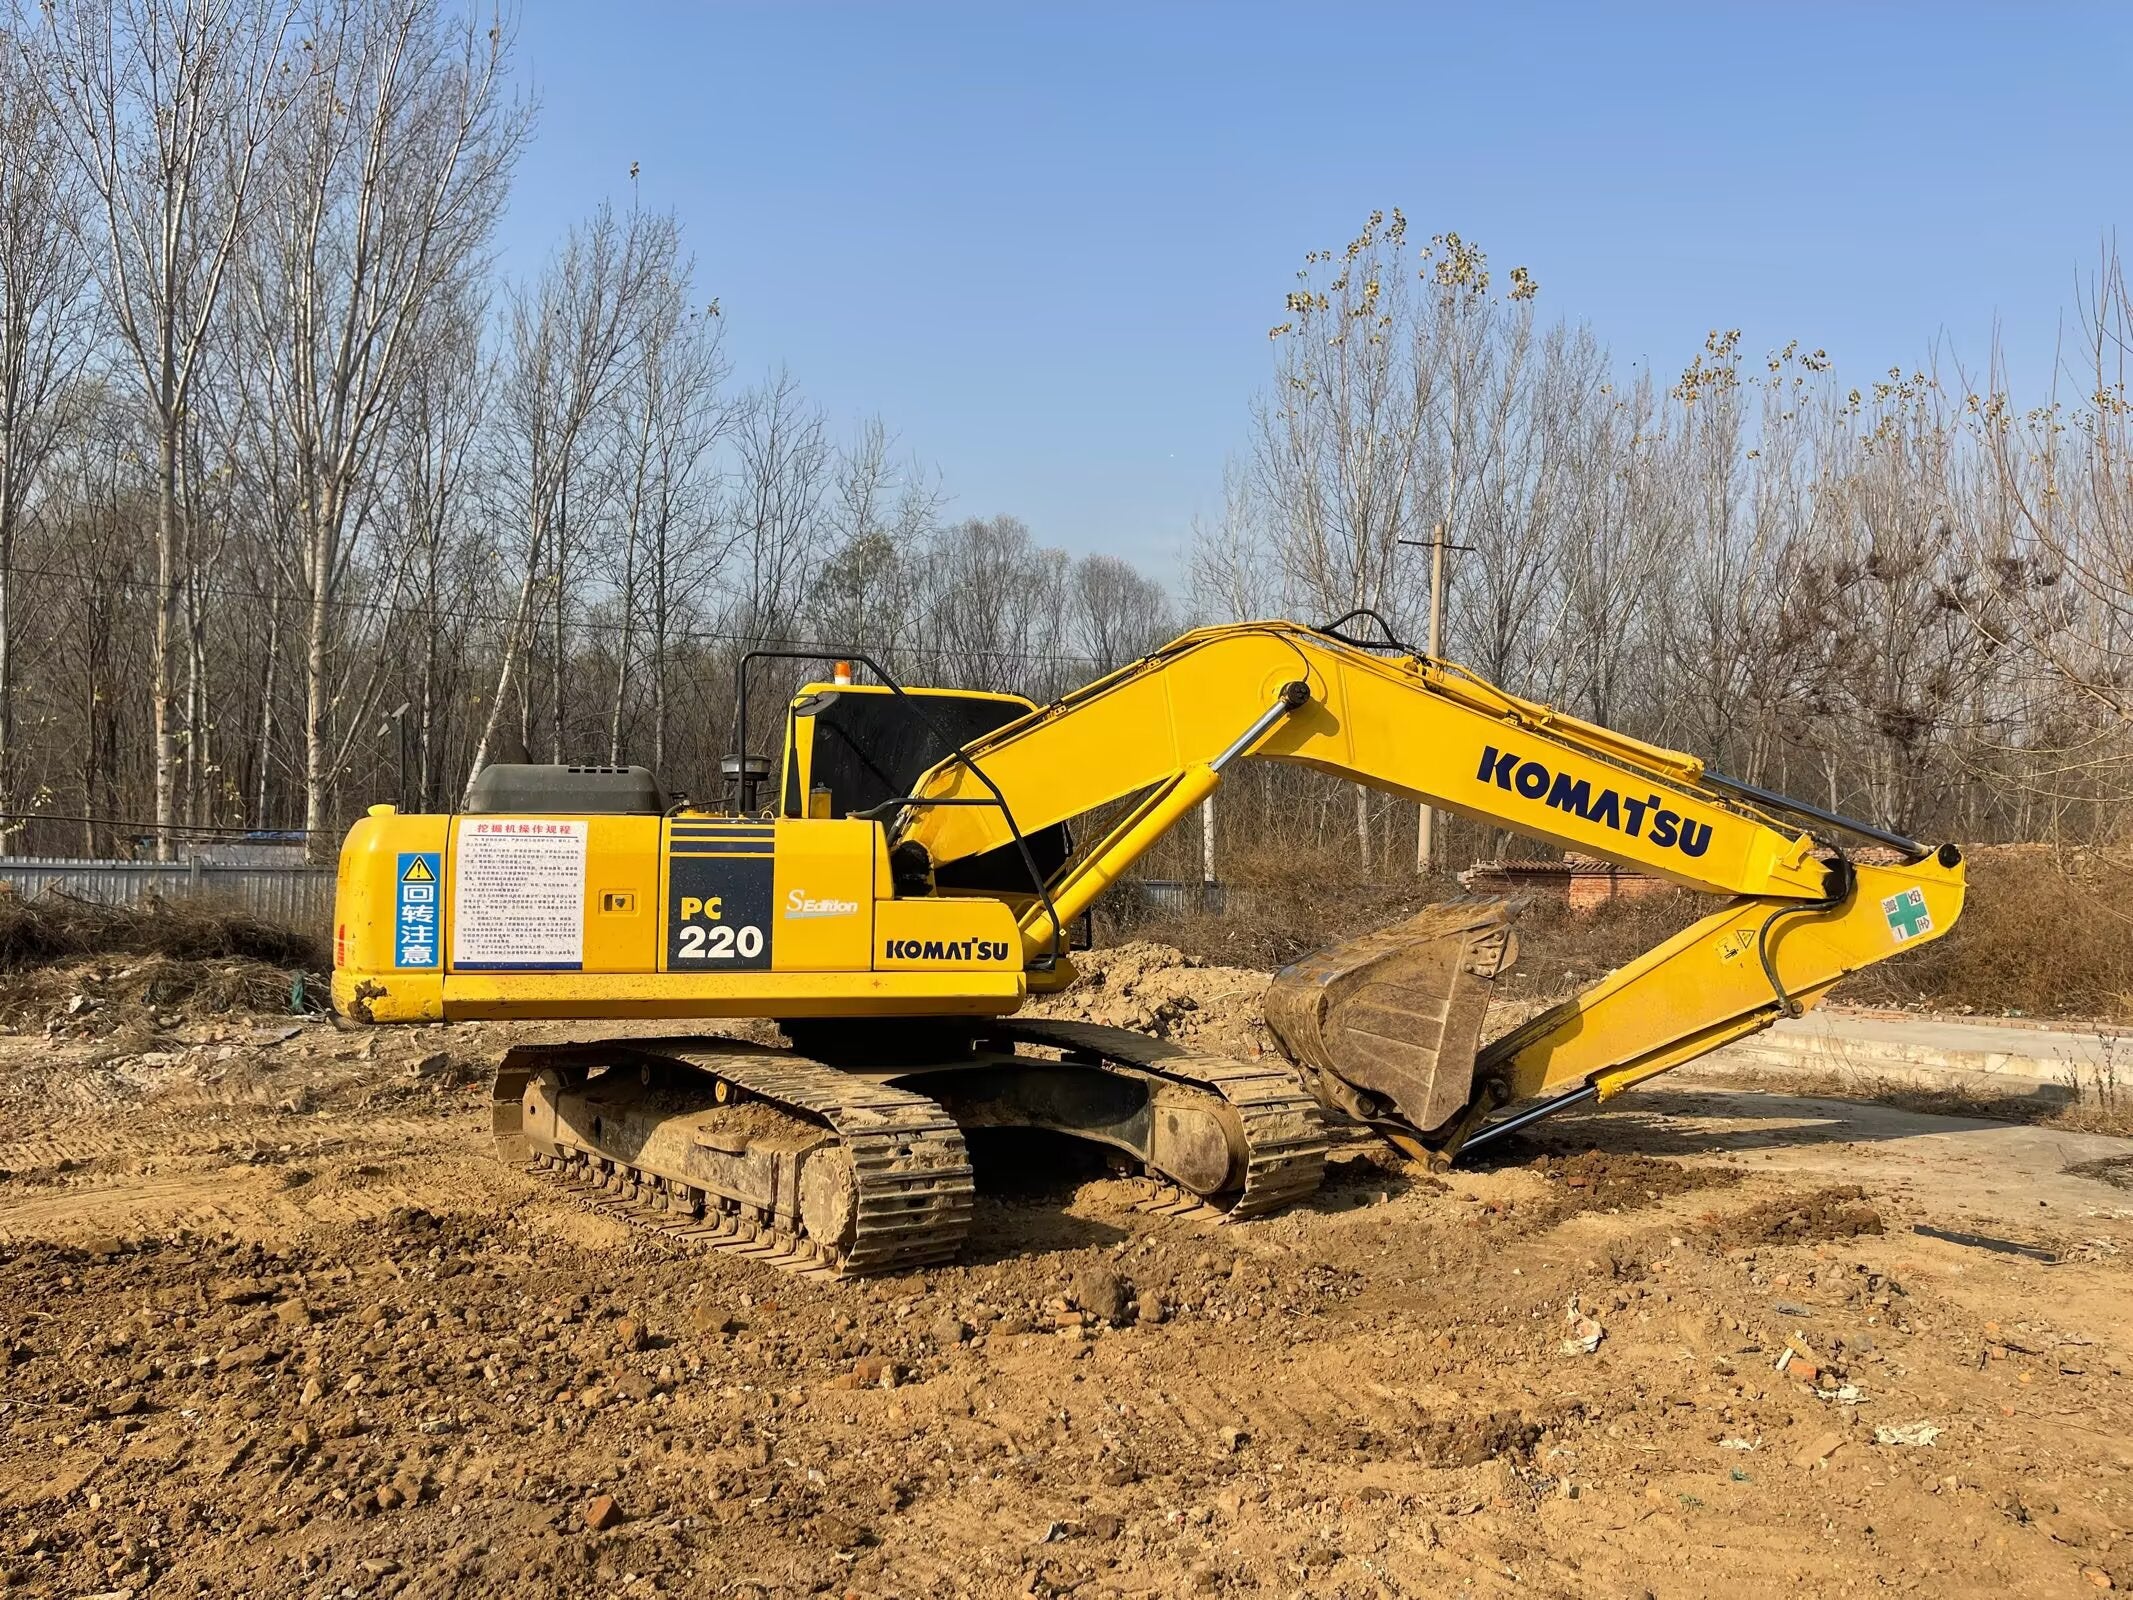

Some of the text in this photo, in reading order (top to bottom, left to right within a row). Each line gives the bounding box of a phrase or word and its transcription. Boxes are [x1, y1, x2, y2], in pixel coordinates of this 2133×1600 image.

[1477, 745, 1713, 857] KOMATSU
[477, 824, 571, 834] 挖掘机操作规程
[680, 897, 722, 920] PC
[401, 885, 434, 963] 回转注意
[678, 925, 764, 958] 220
[886, 937, 1008, 960] KOMATSU
